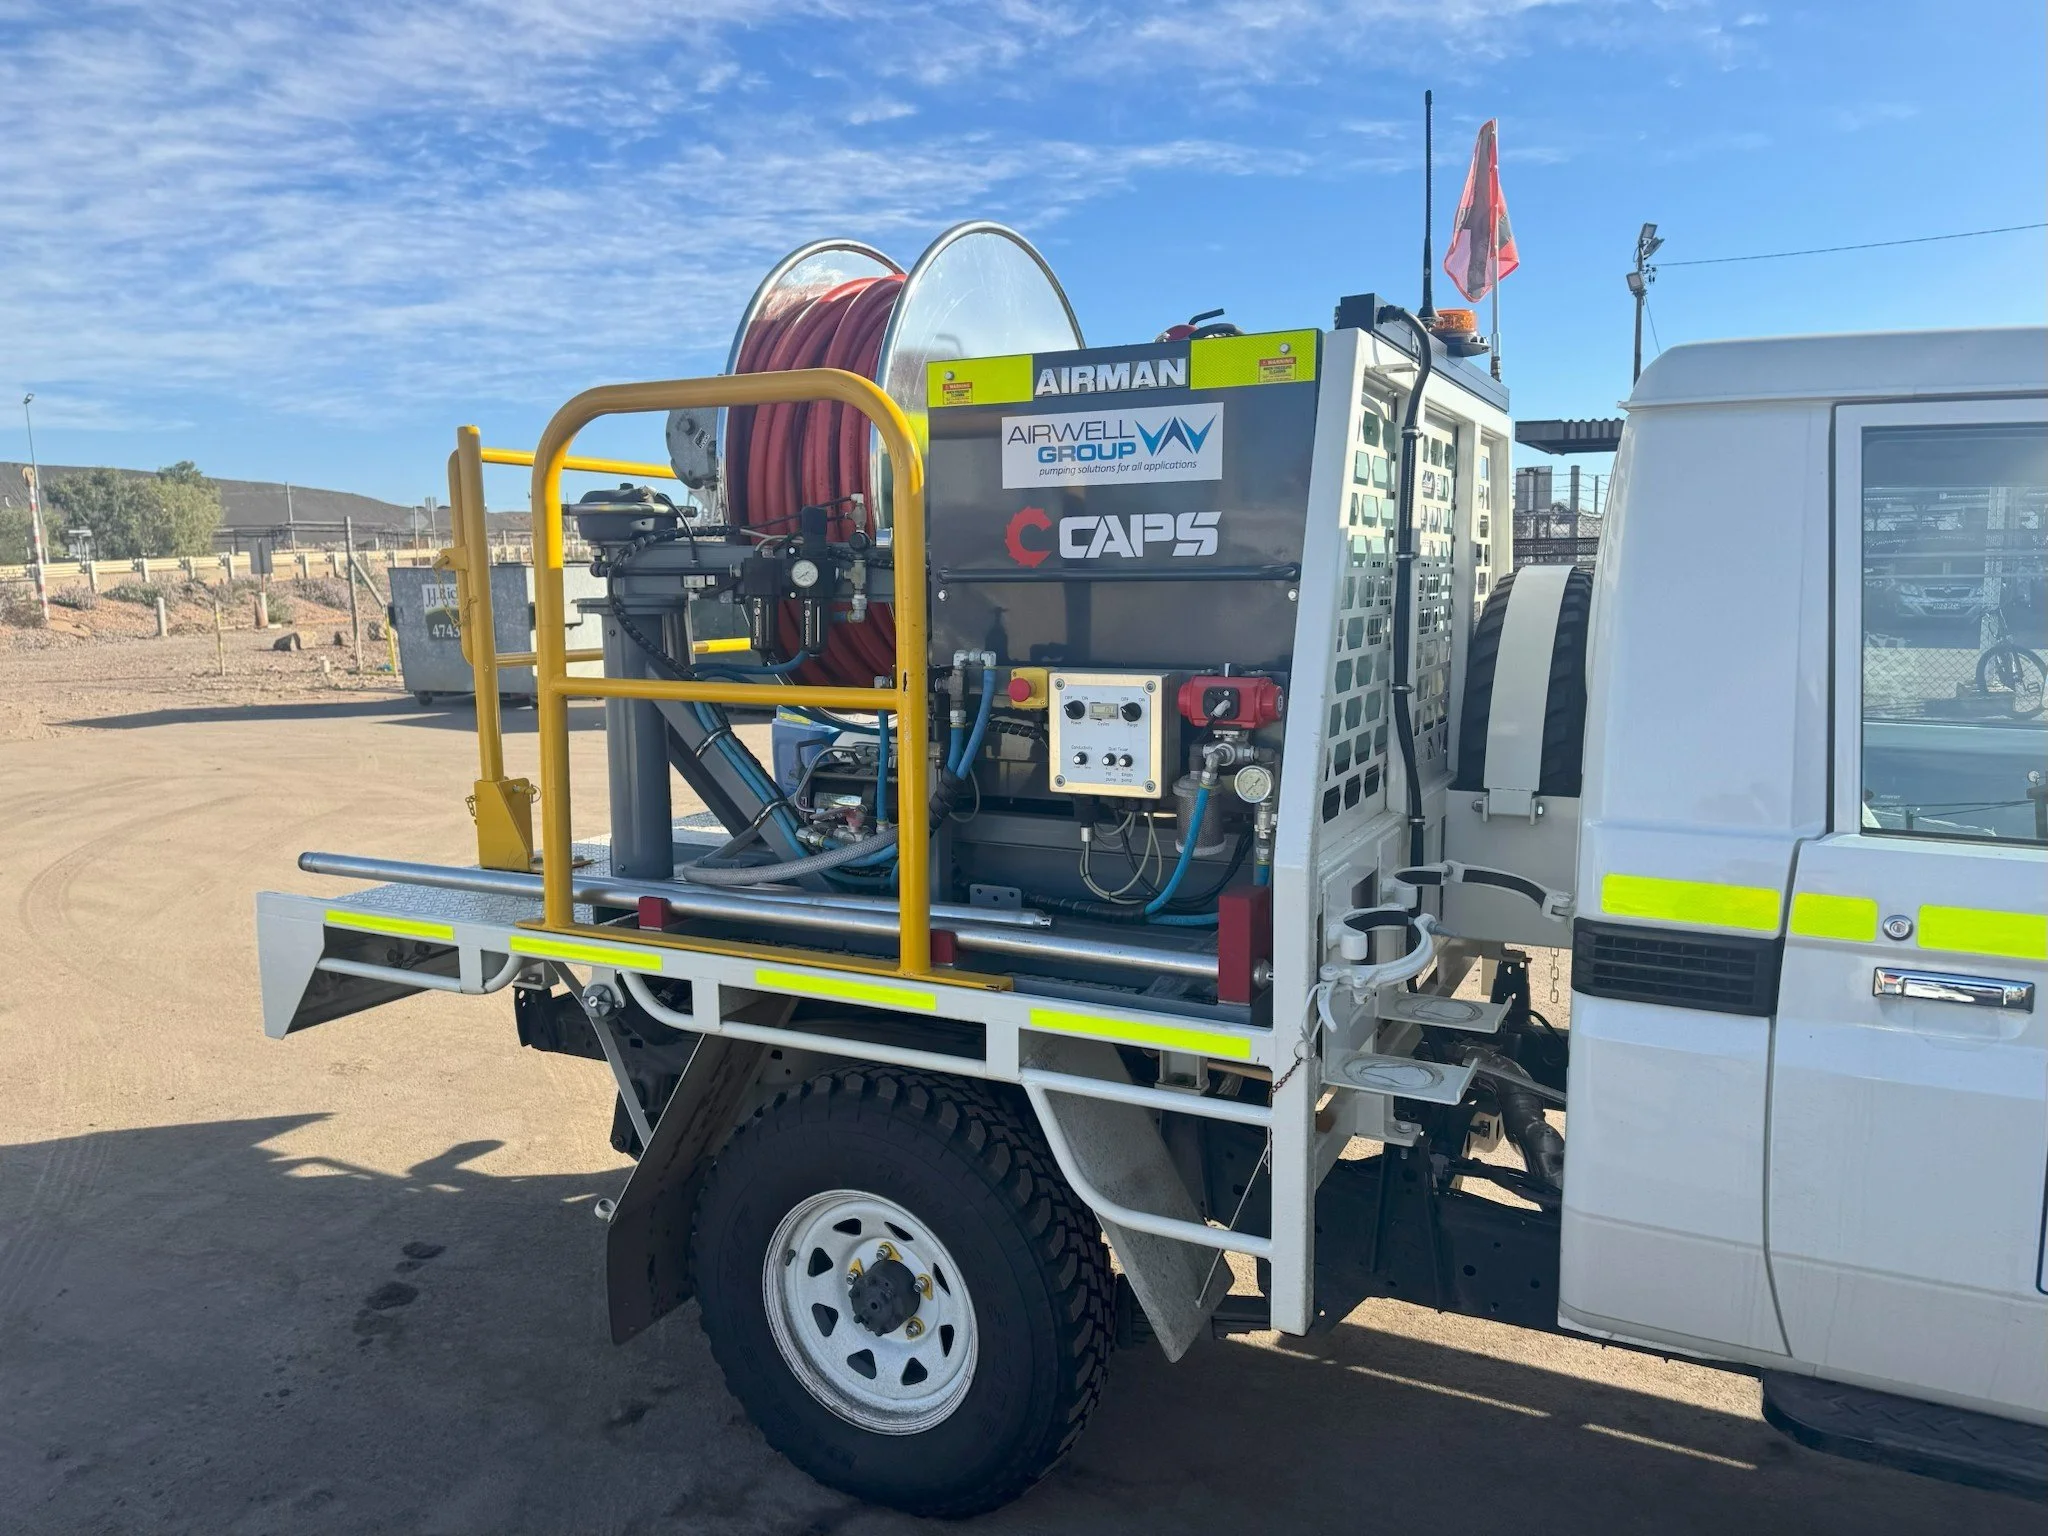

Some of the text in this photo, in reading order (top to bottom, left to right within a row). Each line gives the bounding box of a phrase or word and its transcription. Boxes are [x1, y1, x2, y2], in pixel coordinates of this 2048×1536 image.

[1034, 357, 1187, 397] AIRMAN
[1007, 419, 1136, 445] AIRWELL
[1037, 441, 1137, 464] GROUP
[1039, 459, 1198, 477] pumping solutions for all applications
[1058, 511, 1224, 560] CAPS
